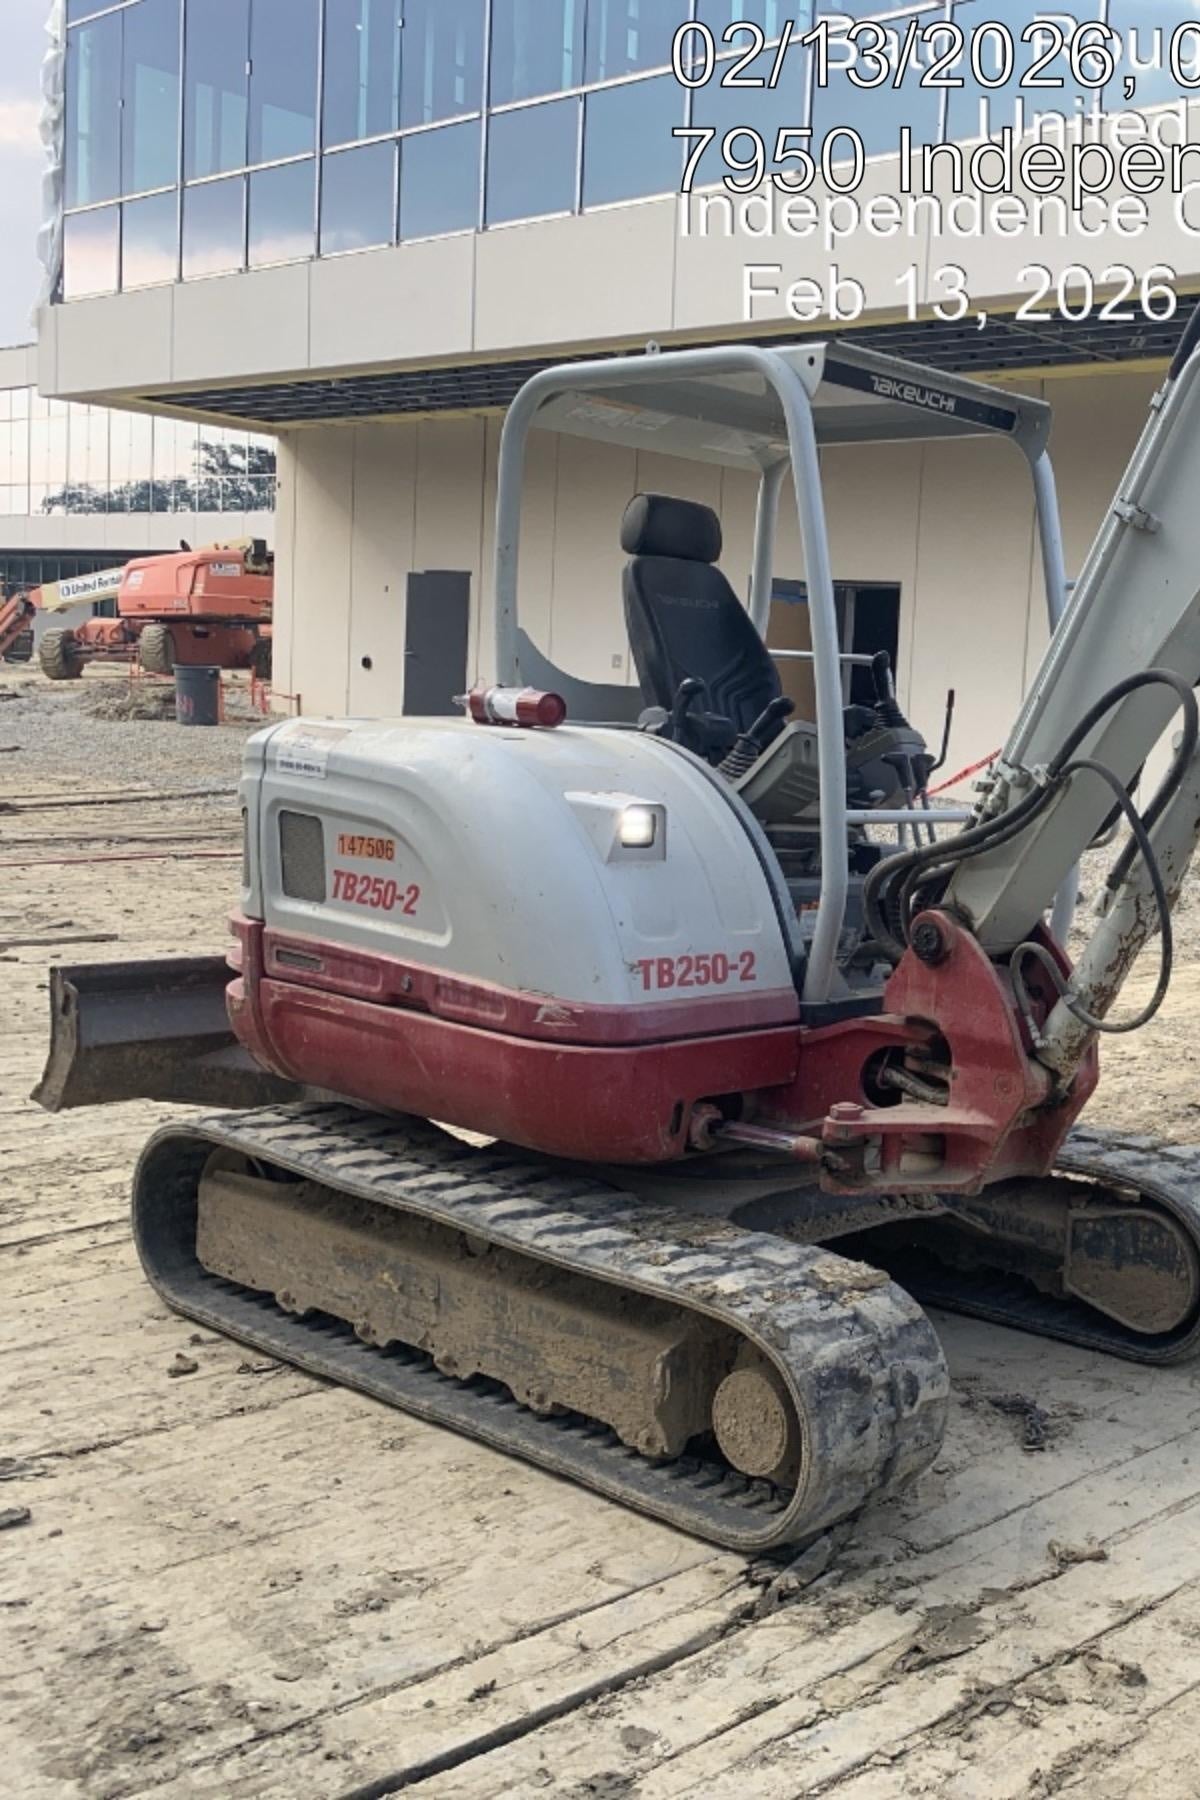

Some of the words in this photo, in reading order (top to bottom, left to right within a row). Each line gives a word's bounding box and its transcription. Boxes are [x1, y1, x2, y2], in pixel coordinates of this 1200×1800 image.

[338, 833, 395, 861] 147506
[331, 868, 421, 916] TB250-2
[638, 950, 757, 991] TB250-2
